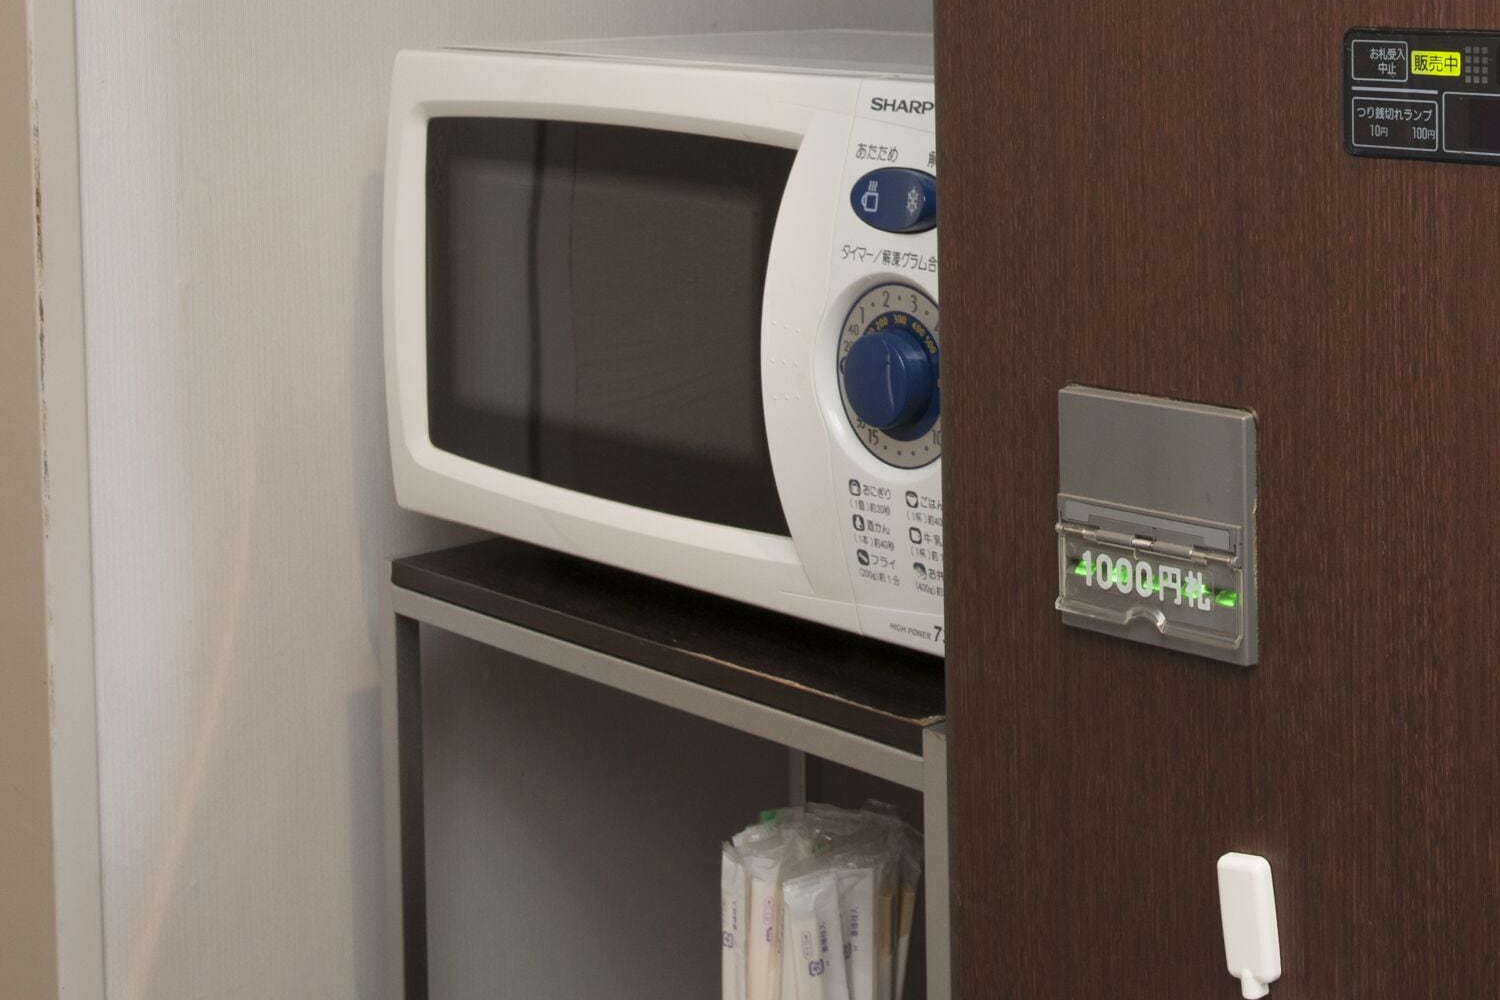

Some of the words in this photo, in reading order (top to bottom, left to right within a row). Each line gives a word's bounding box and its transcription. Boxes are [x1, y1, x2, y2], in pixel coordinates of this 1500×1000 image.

[1369, 47, 1406, 62] お札受入
[1378, 62, 1397, 75] 中止
[1414, 54, 1459, 73] 販売中
[870, 97, 935, 116] SHARP
[1356, 106, 1433, 122] つり銭切れランプ
[1370, 124, 1389, 138] 10円
[1412, 126, 1436, 141] 100円
[855, 143, 899, 163] あたため
[882, 290, 891, 308] 2
[910, 294, 918, 314] 3
[859, 306, 865, 324] 1
[867, 428, 879, 445] 15
[862, 483, 892, 500] おにぎり
[869, 554, 896, 570] フライ
[1082, 549, 1212, 612] 1000円札
[889, 622, 907, 634] HIGH
[907, 627, 932, 641] POWER
